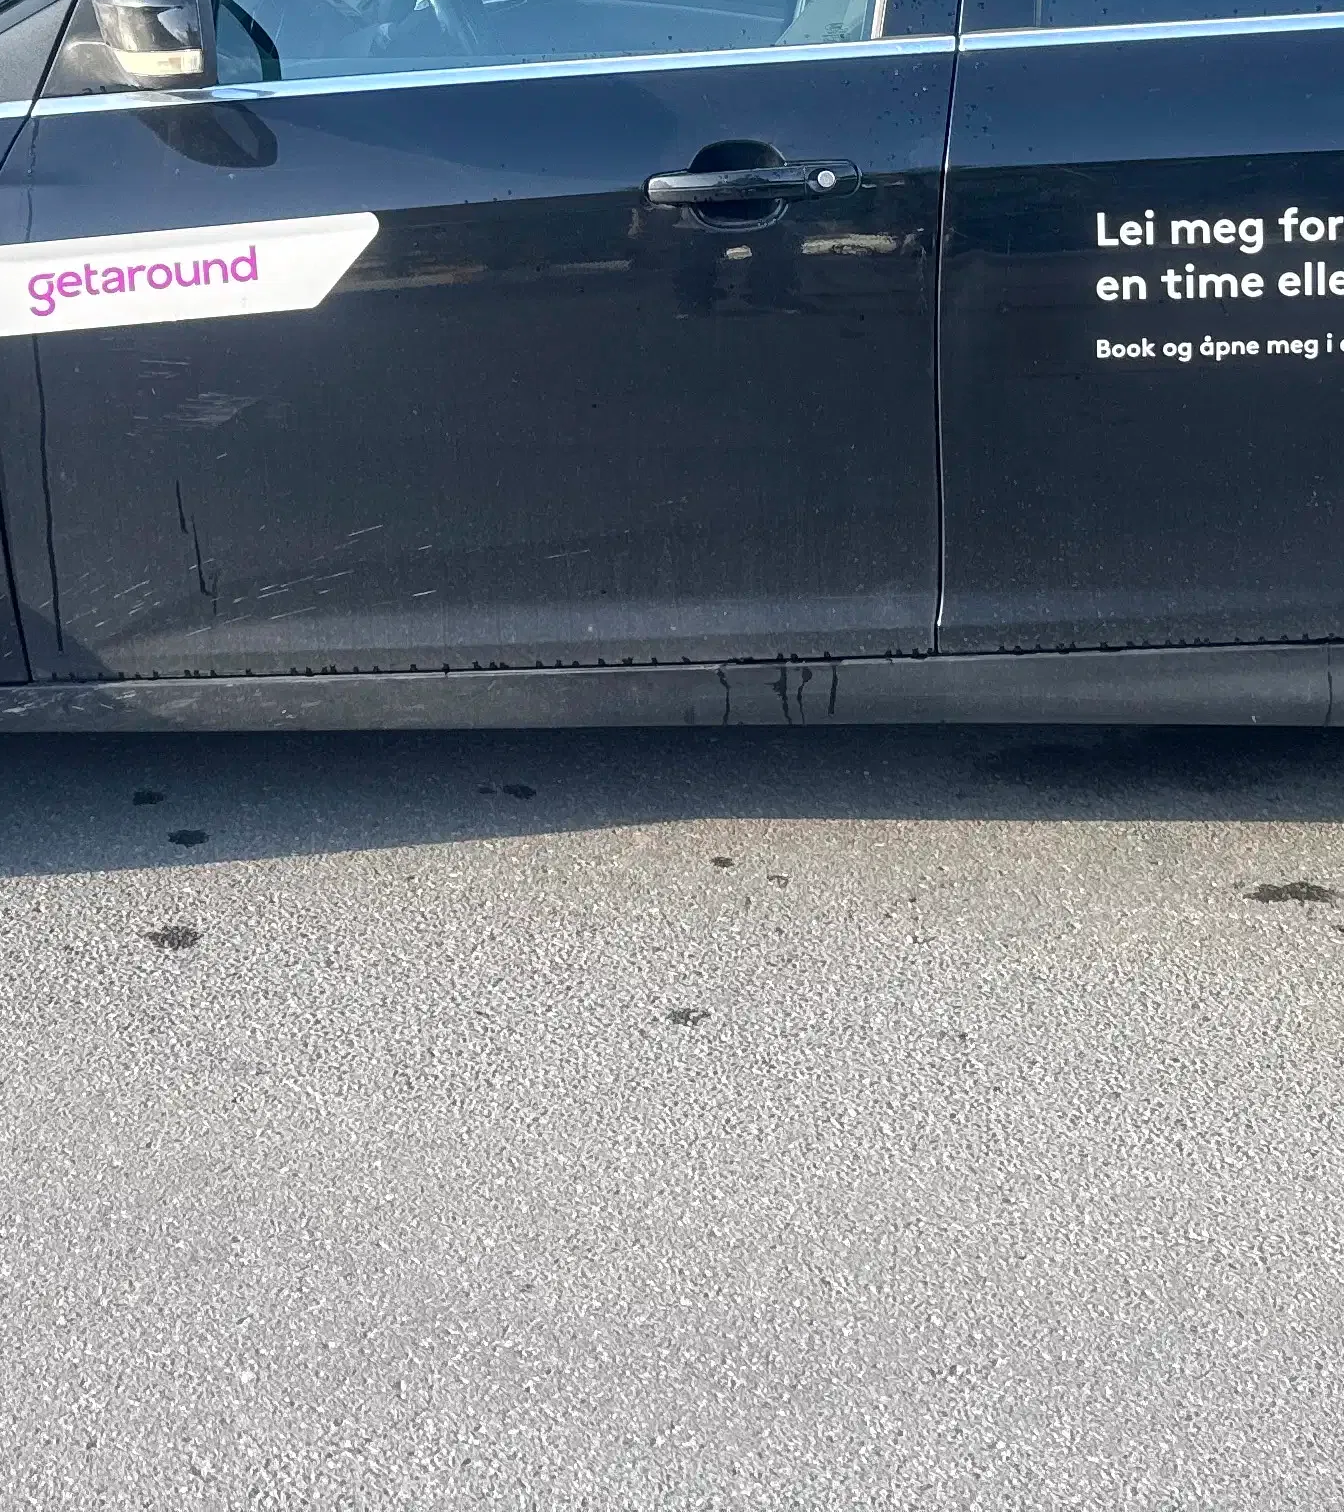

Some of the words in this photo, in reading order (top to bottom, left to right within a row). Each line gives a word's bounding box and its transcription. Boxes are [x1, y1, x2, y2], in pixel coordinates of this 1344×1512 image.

[1096, 209, 1155, 247] Lei
[1170, 214, 1264, 255] meg
[1277, 206, 1344, 242] for
[27, 245, 259, 317] getaround
[1096, 274, 1147, 301] en
[1160, 263, 1265, 300] time
[1096, 337, 1156, 359] Book
[1162, 342, 1193, 362] og
[1199, 335, 1260, 362] åpne
[1266, 339, 1319, 360] meg
[1326, 332, 1334, 354] i
